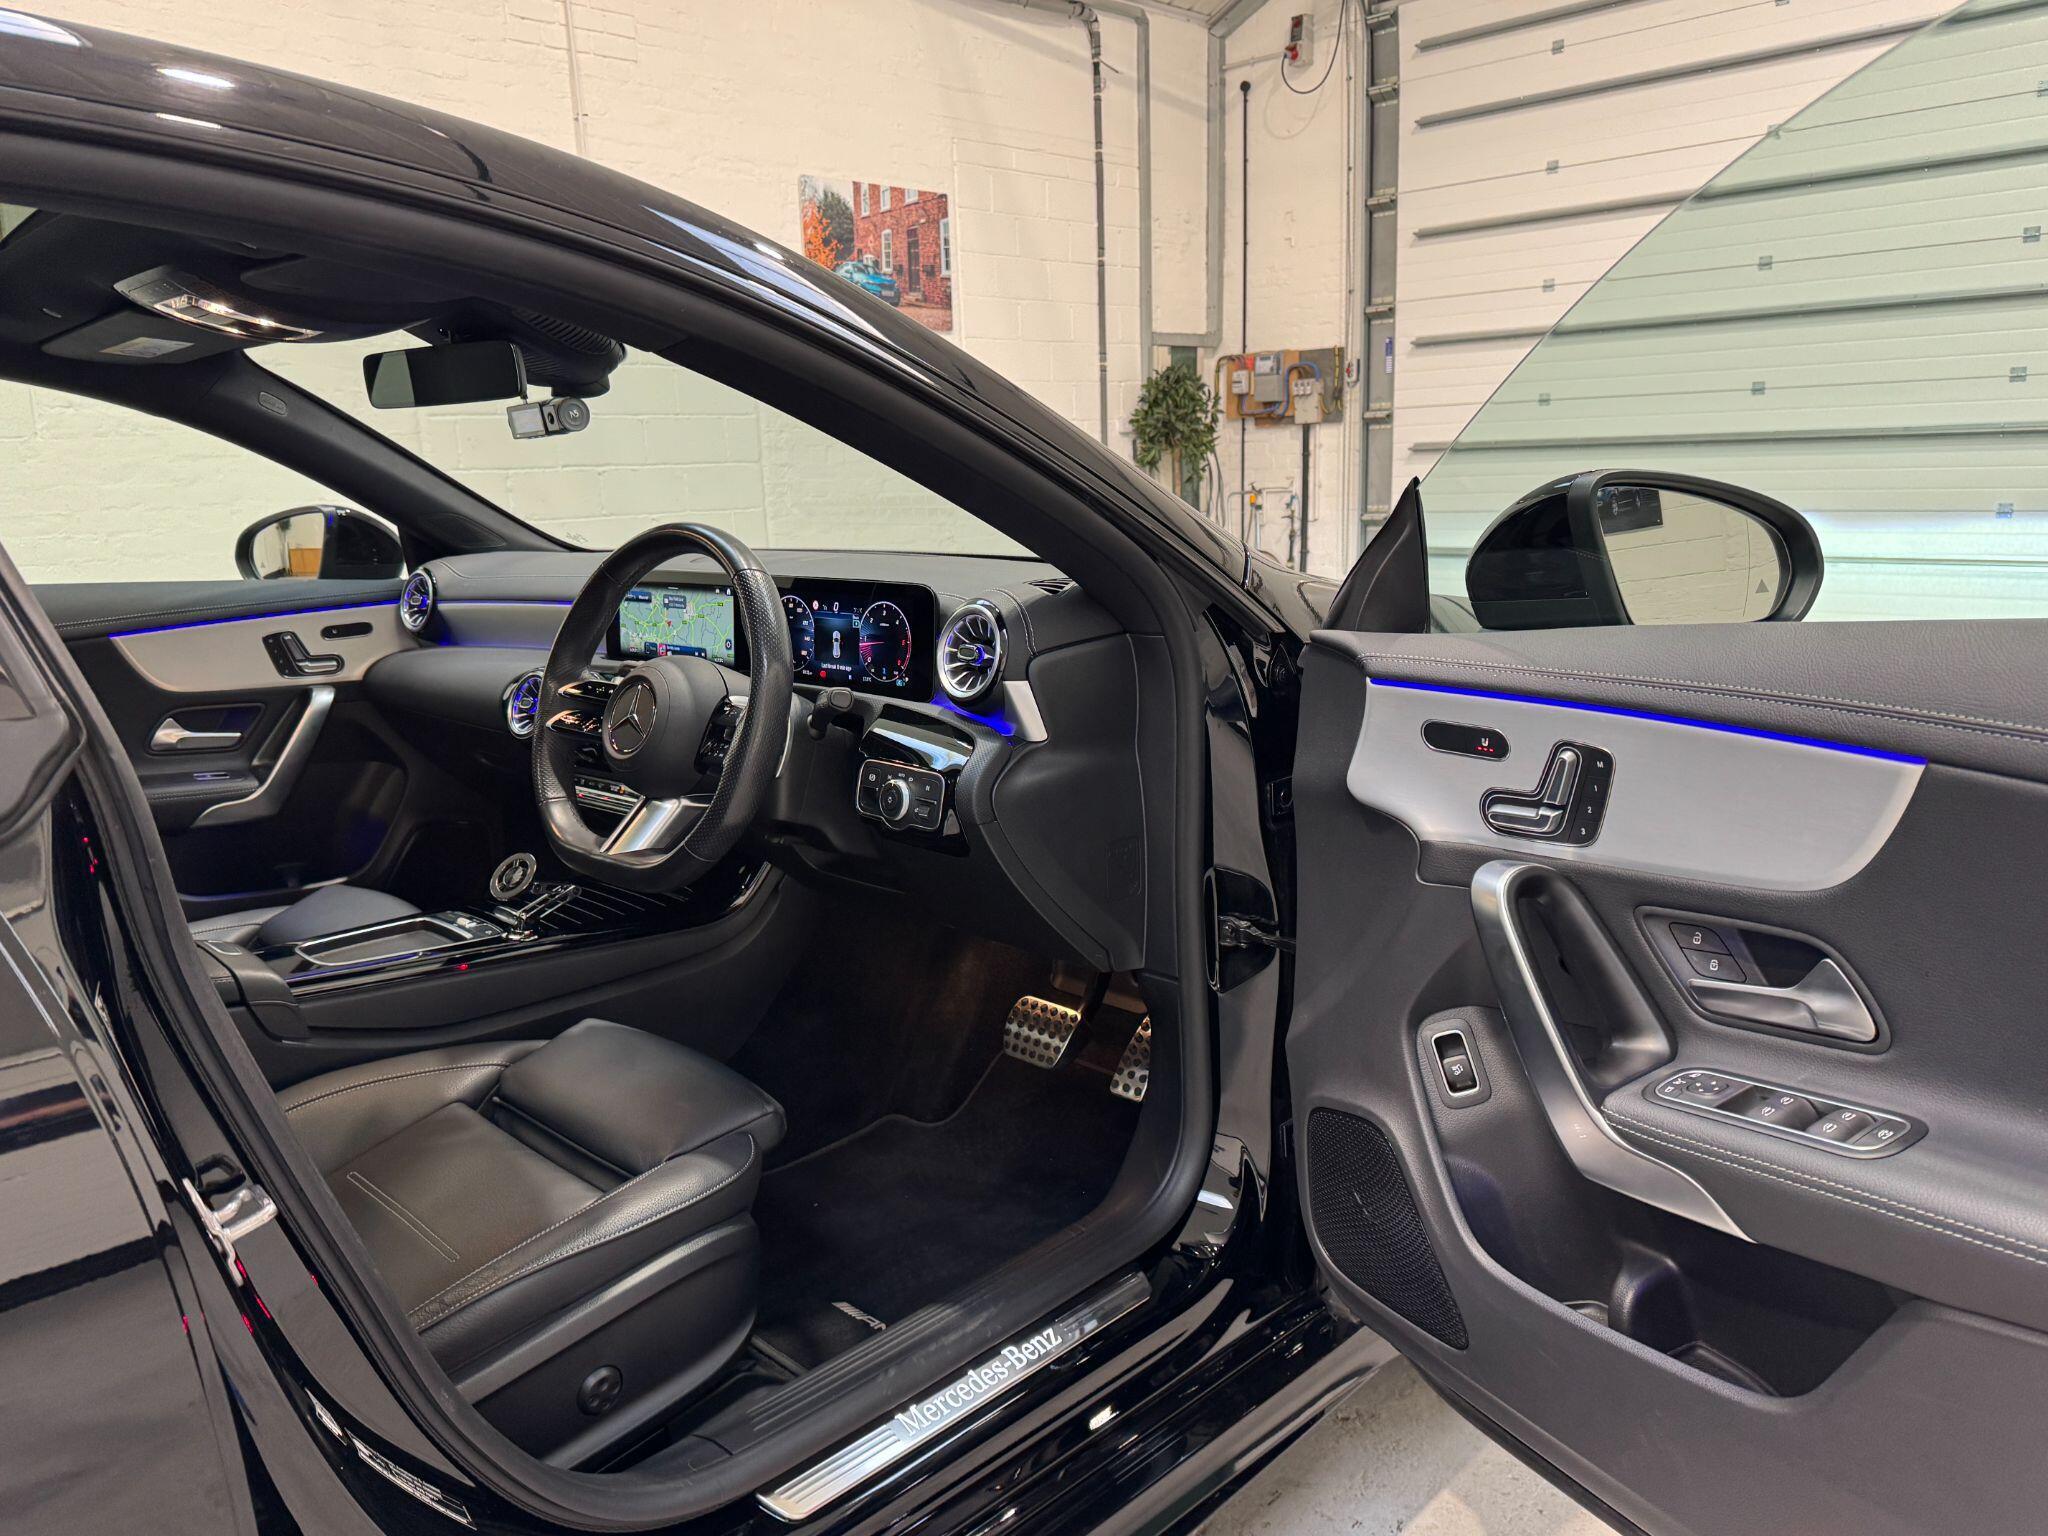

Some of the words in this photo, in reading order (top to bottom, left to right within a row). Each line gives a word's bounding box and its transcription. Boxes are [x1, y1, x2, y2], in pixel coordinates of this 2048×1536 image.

[1596, 760, 1604, 769] M
[1593, 784, 1598, 792] 1
[1587, 806, 1593, 814] 2
[1581, 827, 1586, 835] 3
[895, 1326, 1063, 1438] Mercedes-Benz
